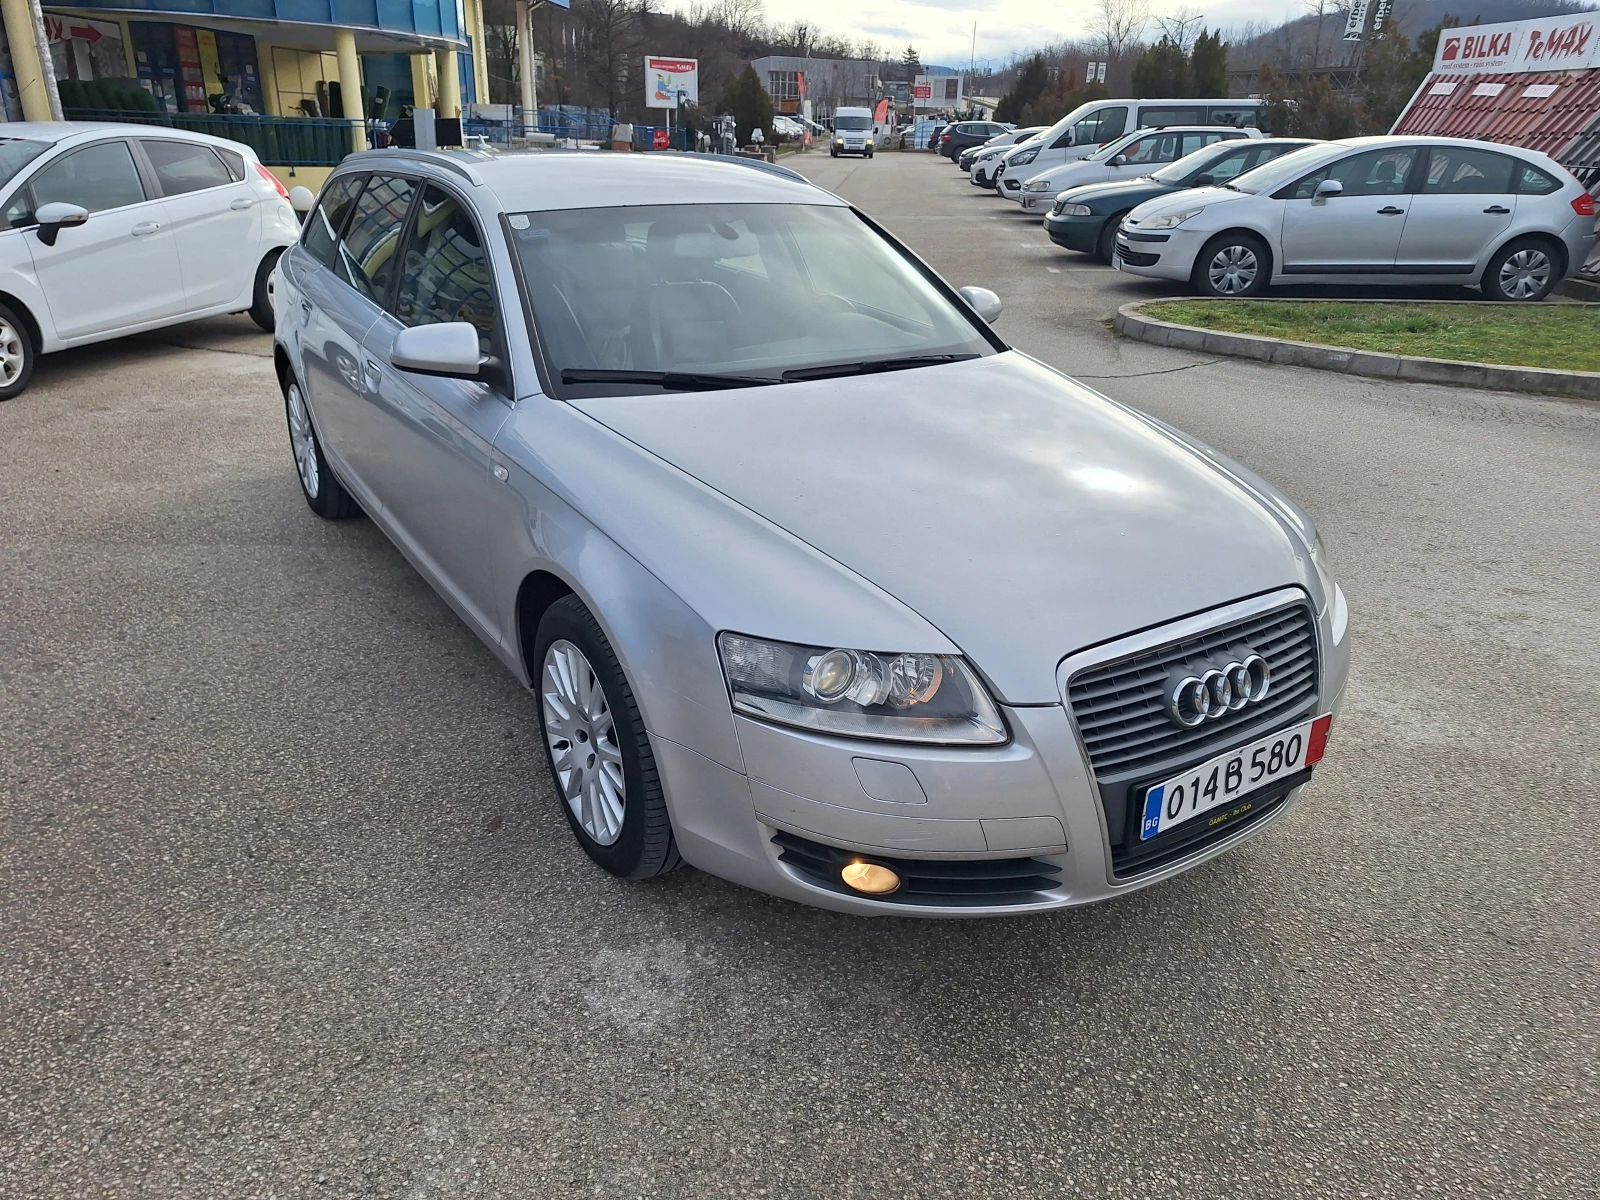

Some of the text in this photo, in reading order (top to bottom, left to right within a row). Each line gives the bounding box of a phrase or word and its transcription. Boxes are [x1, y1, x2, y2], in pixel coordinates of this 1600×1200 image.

[1349, 0, 1362, 28] efbe
[1461, 32, 1512, 59] BILKA
[1523, 24, 1594, 62] TeMAX
[1441, 60, 1504, 71] roof system rain system
[1144, 816, 1159, 831] BG
